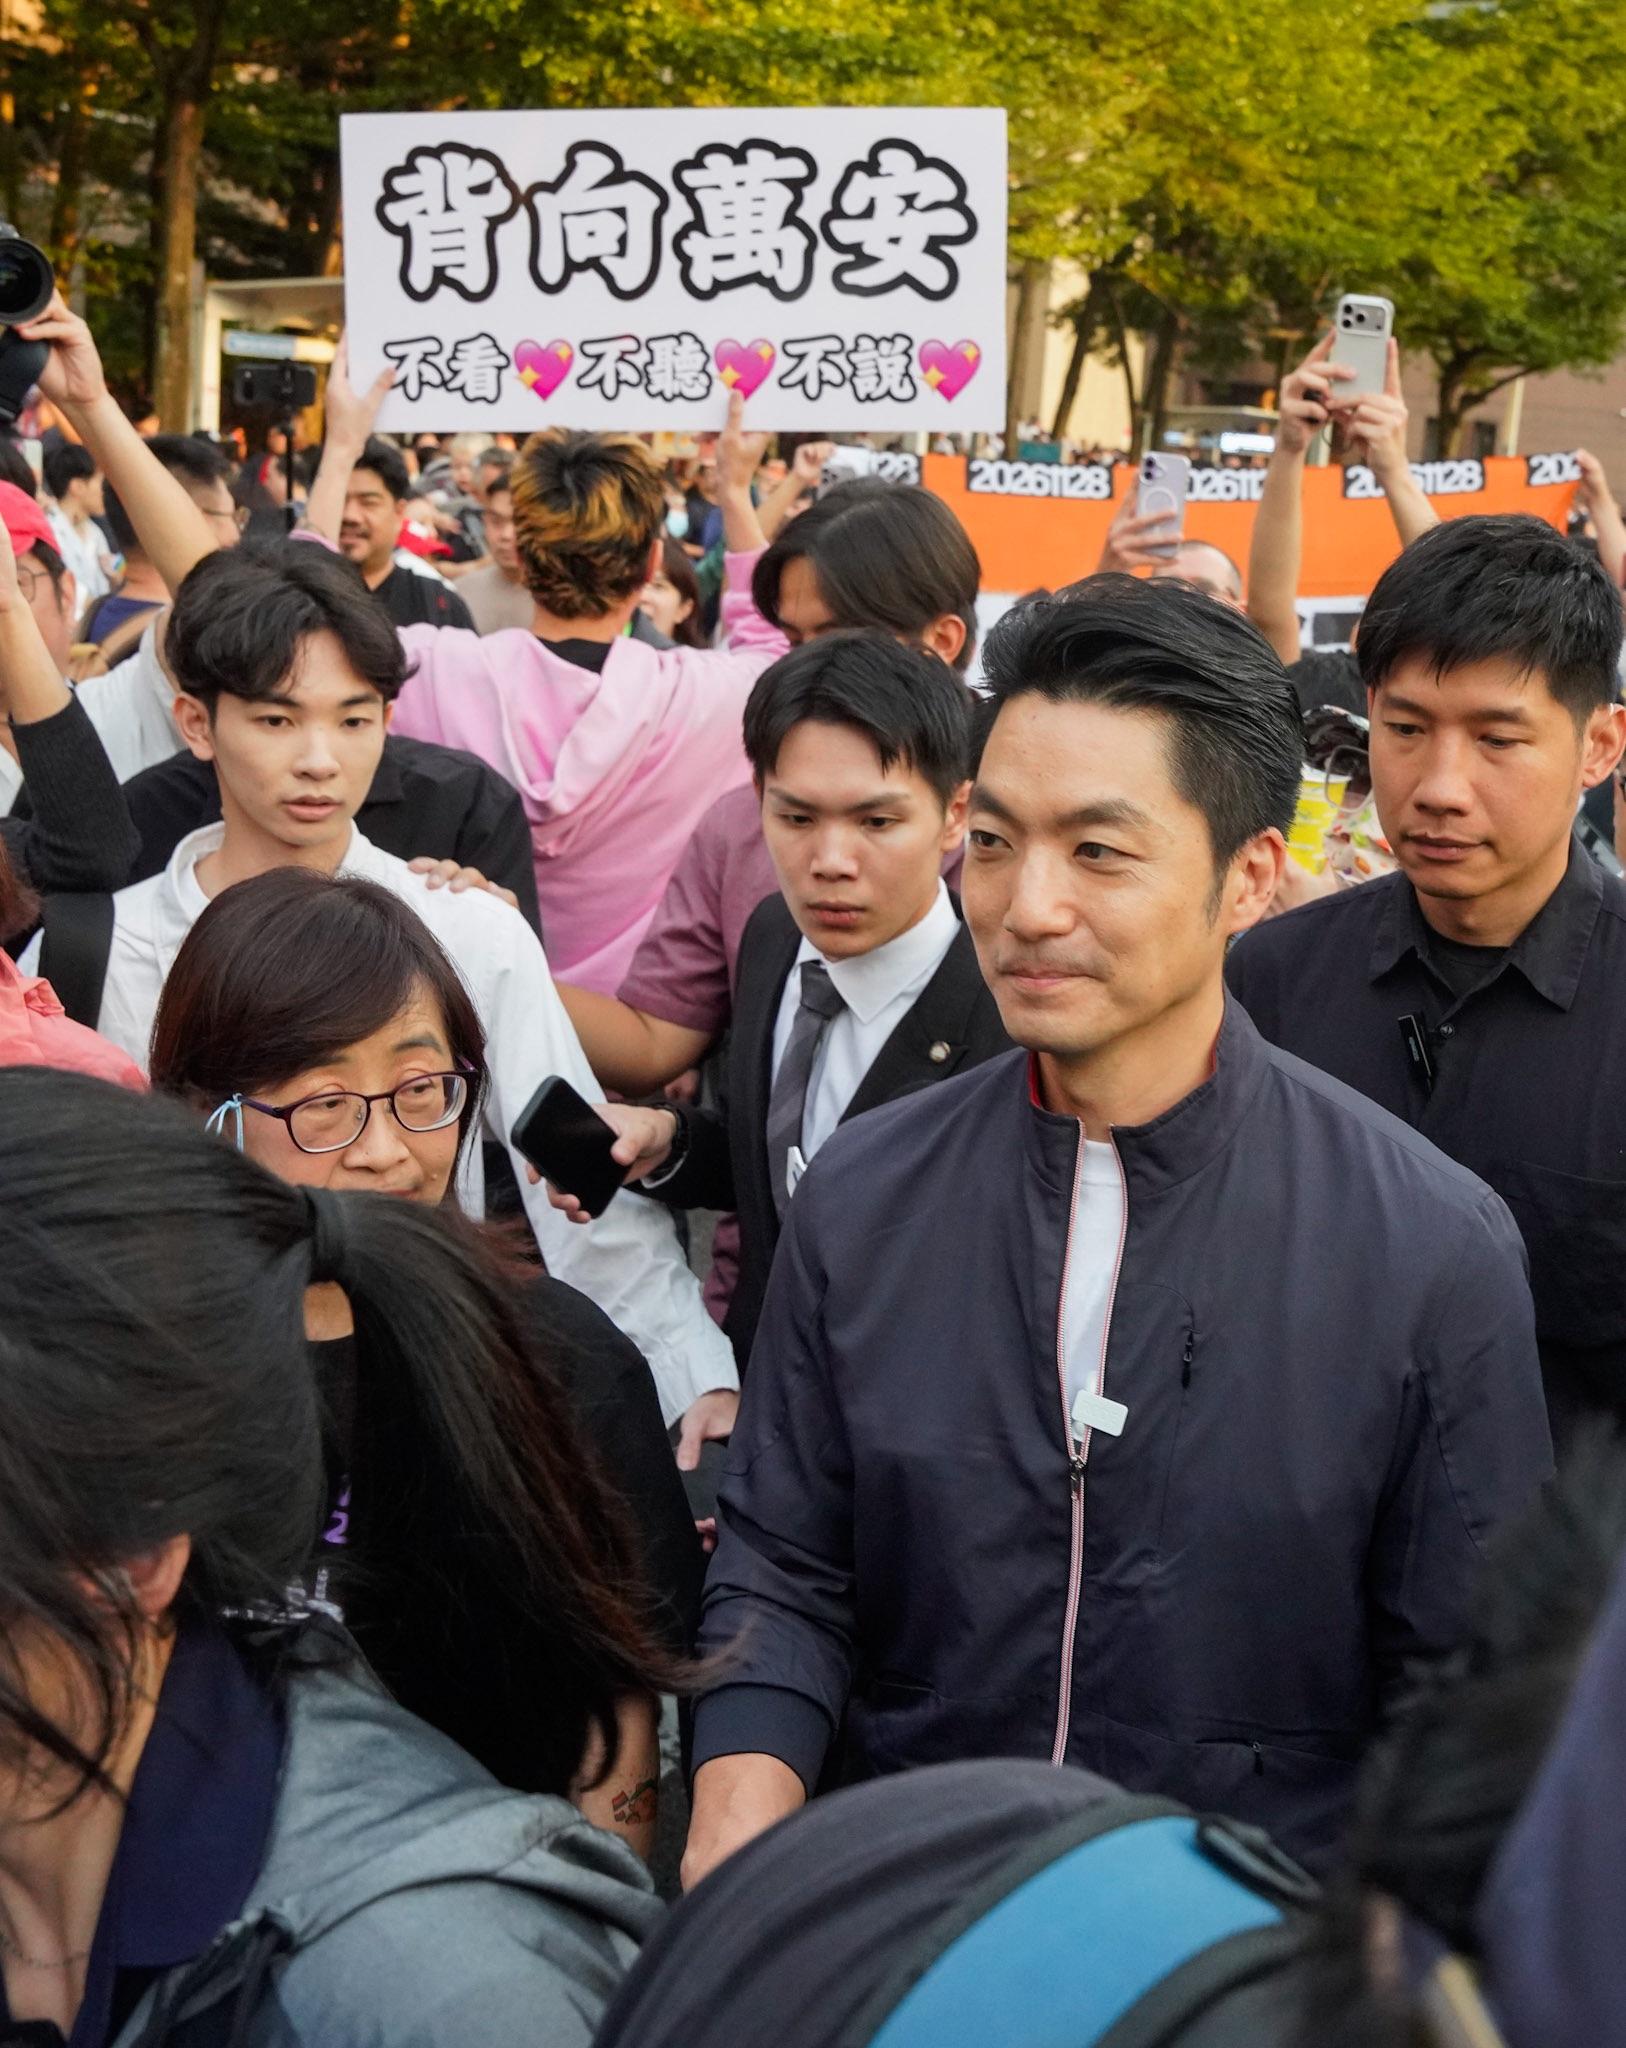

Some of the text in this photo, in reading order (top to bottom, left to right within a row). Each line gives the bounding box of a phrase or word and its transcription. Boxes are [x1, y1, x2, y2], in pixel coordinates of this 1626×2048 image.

[376, 138, 979, 301] 背向萬安
[383, 332, 510, 403] 不看
[576, 331, 713, 402] 不聽
[968, 459, 1111, 499] 20261128
